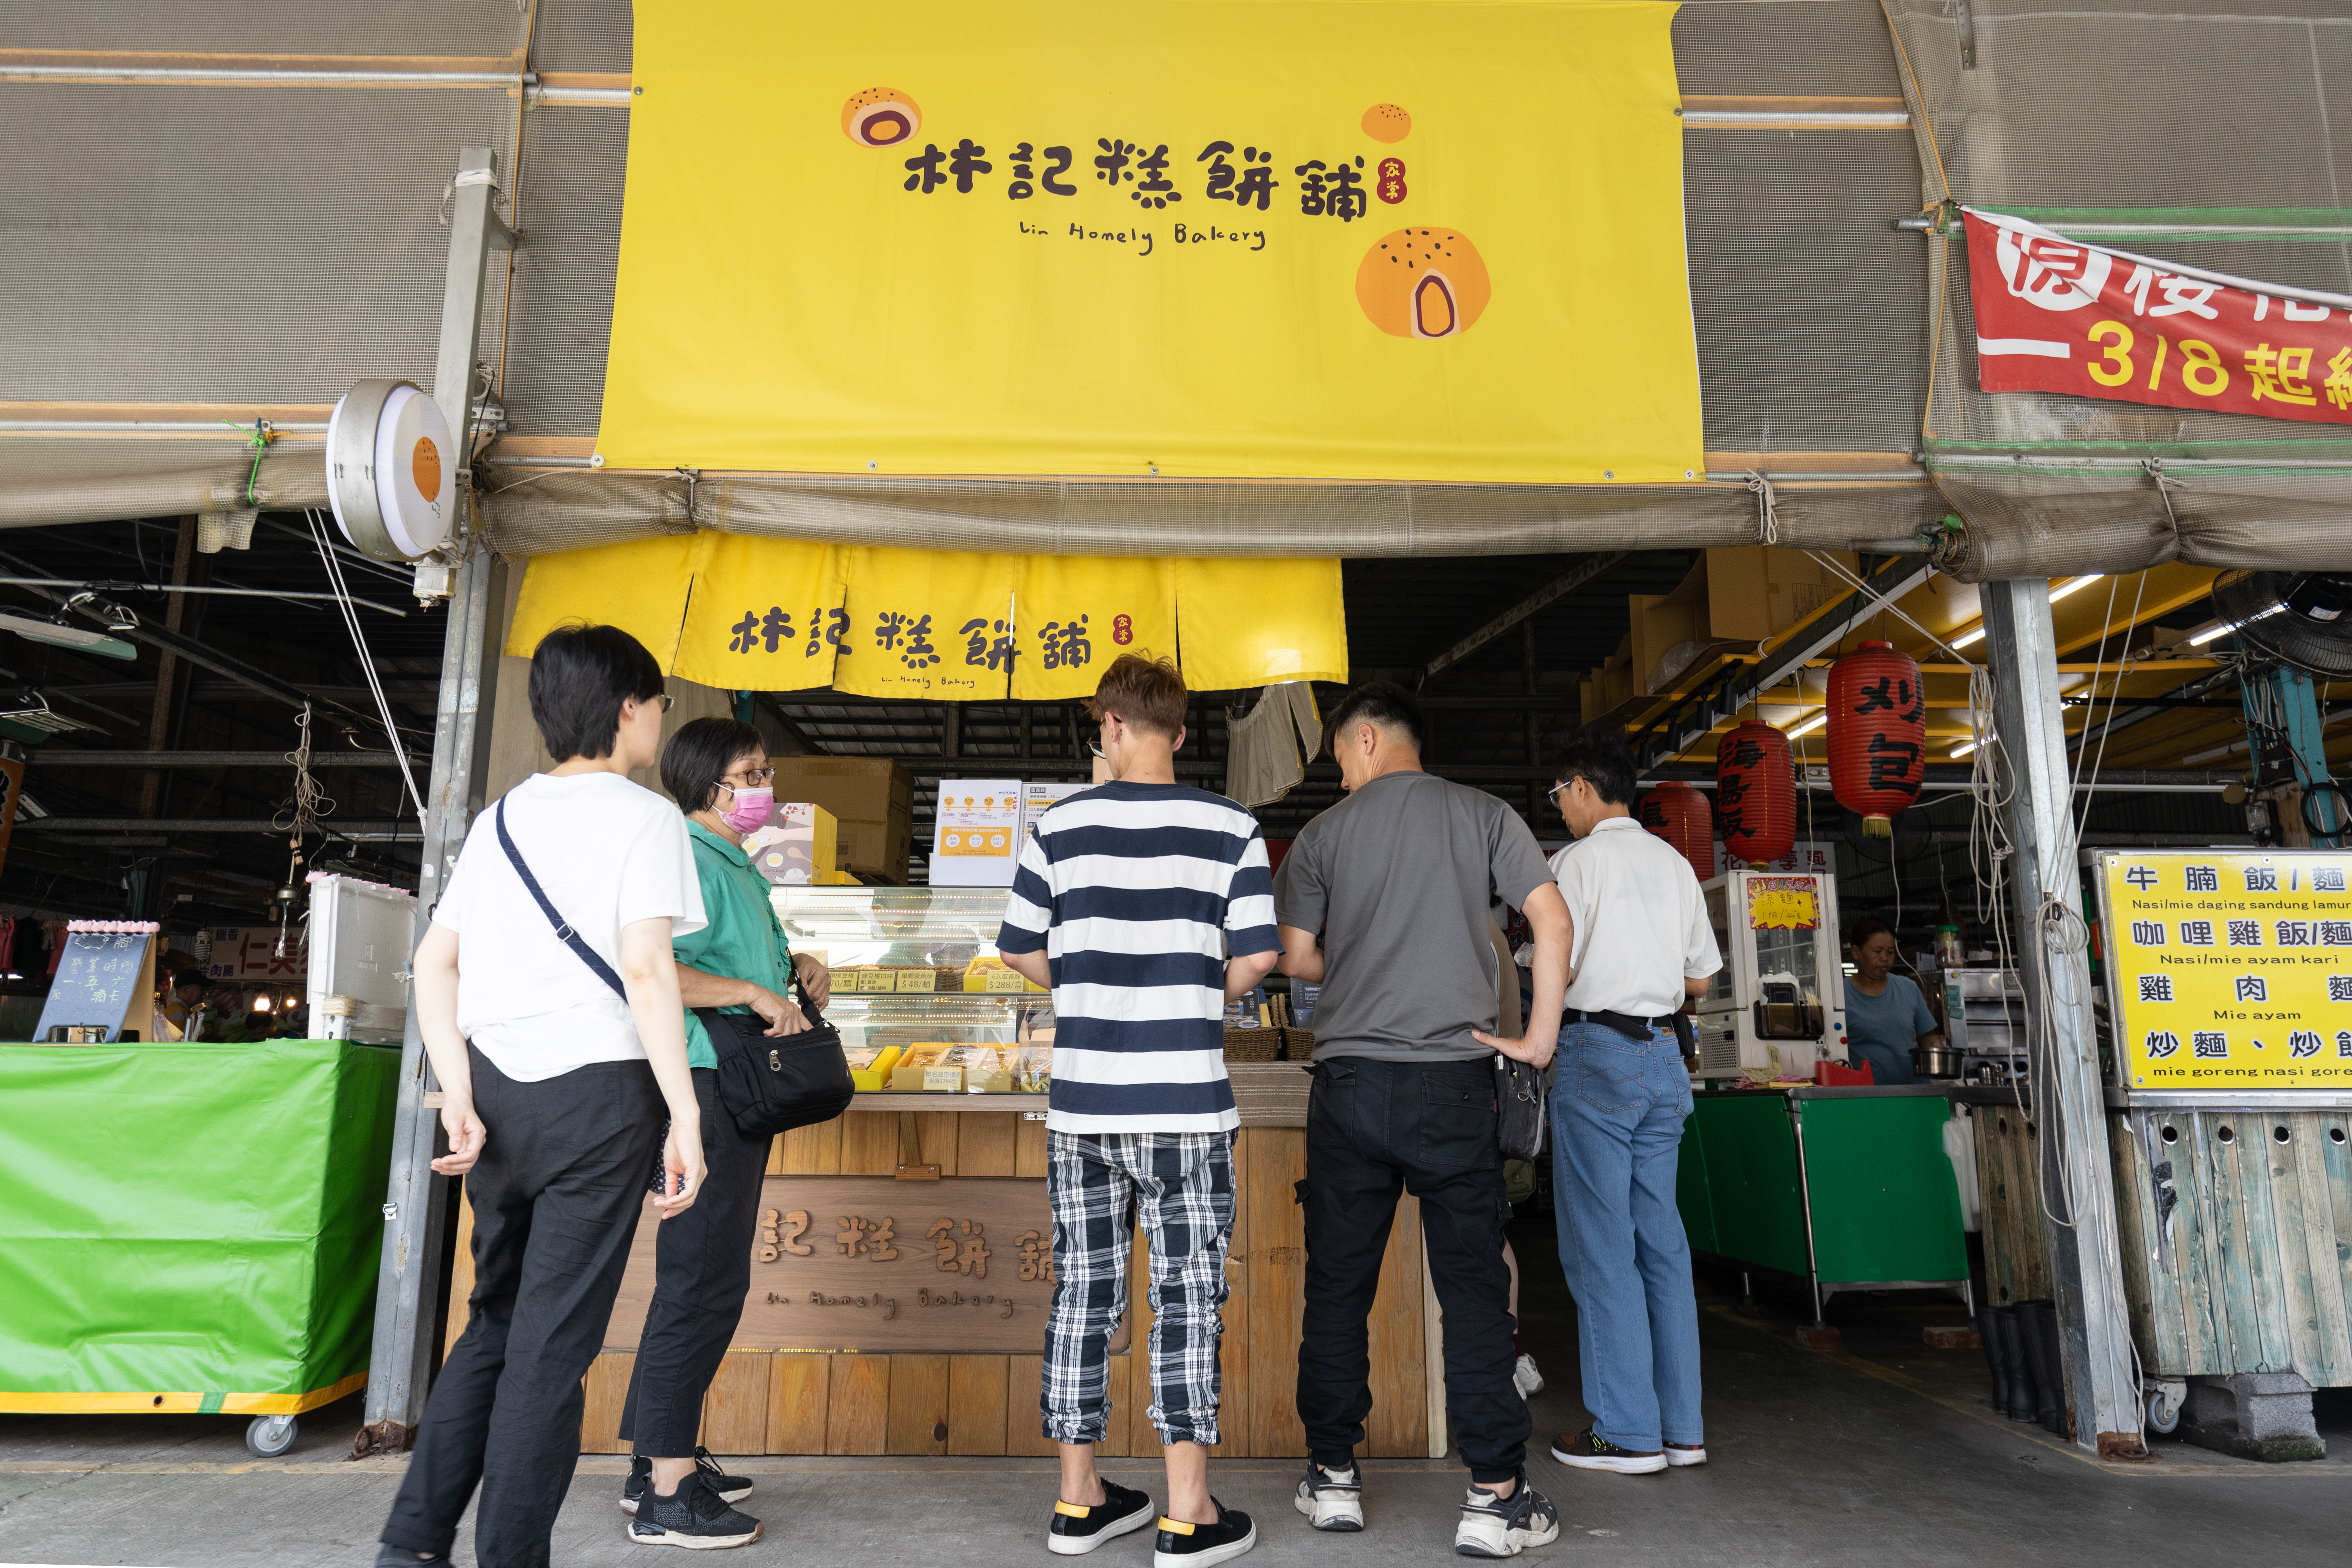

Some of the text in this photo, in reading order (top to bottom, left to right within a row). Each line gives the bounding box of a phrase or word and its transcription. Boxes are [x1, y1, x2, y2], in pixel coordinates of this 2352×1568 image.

[1020, 221, 1265, 256] Lin Homely Bakery
[900, 676, 930, 689] Homely
[941, 677, 975, 688] Bakery
[2133, 899, 2351, 910] Nasi/mie daging sandung lamur
[239, 932, 308, 975] 仁美
[2160, 954, 2241, 964] Nasi/mie
[2301, 955, 2338, 964] kari
[2214, 1010, 2246, 1019] Mie
[2154, 1067, 2185, 1076] mie
[2264, 1066, 2303, 1075] nasi
[810, 1291, 895, 1321] Homely
[918, 1288, 1012, 1318] Bakery
